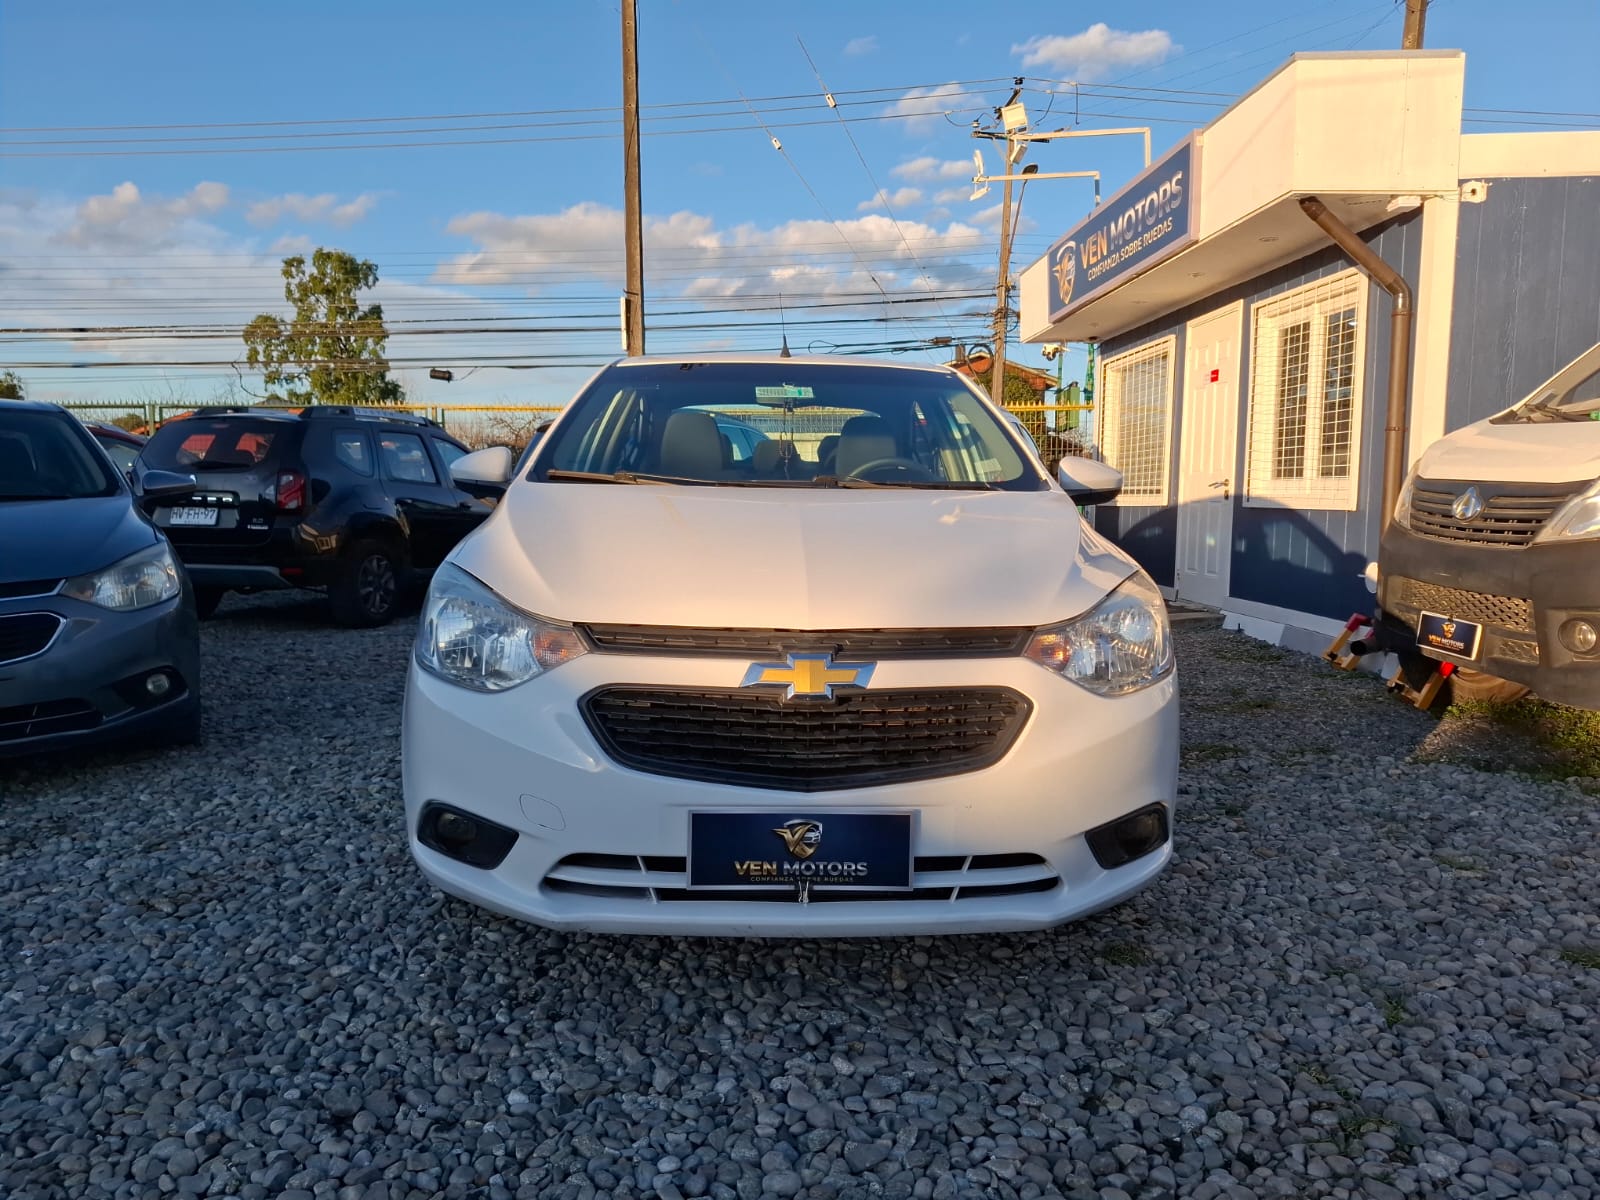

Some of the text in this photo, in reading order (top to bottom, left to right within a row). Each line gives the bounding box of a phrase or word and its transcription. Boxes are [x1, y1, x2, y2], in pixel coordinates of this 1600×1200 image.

[1080, 171, 1182, 270] VEN MOTORS
[1088, 216, 1173, 281] CONFIANZA SOBRE RUEDAS
[734, 861, 868, 876] VEN MOTORS
